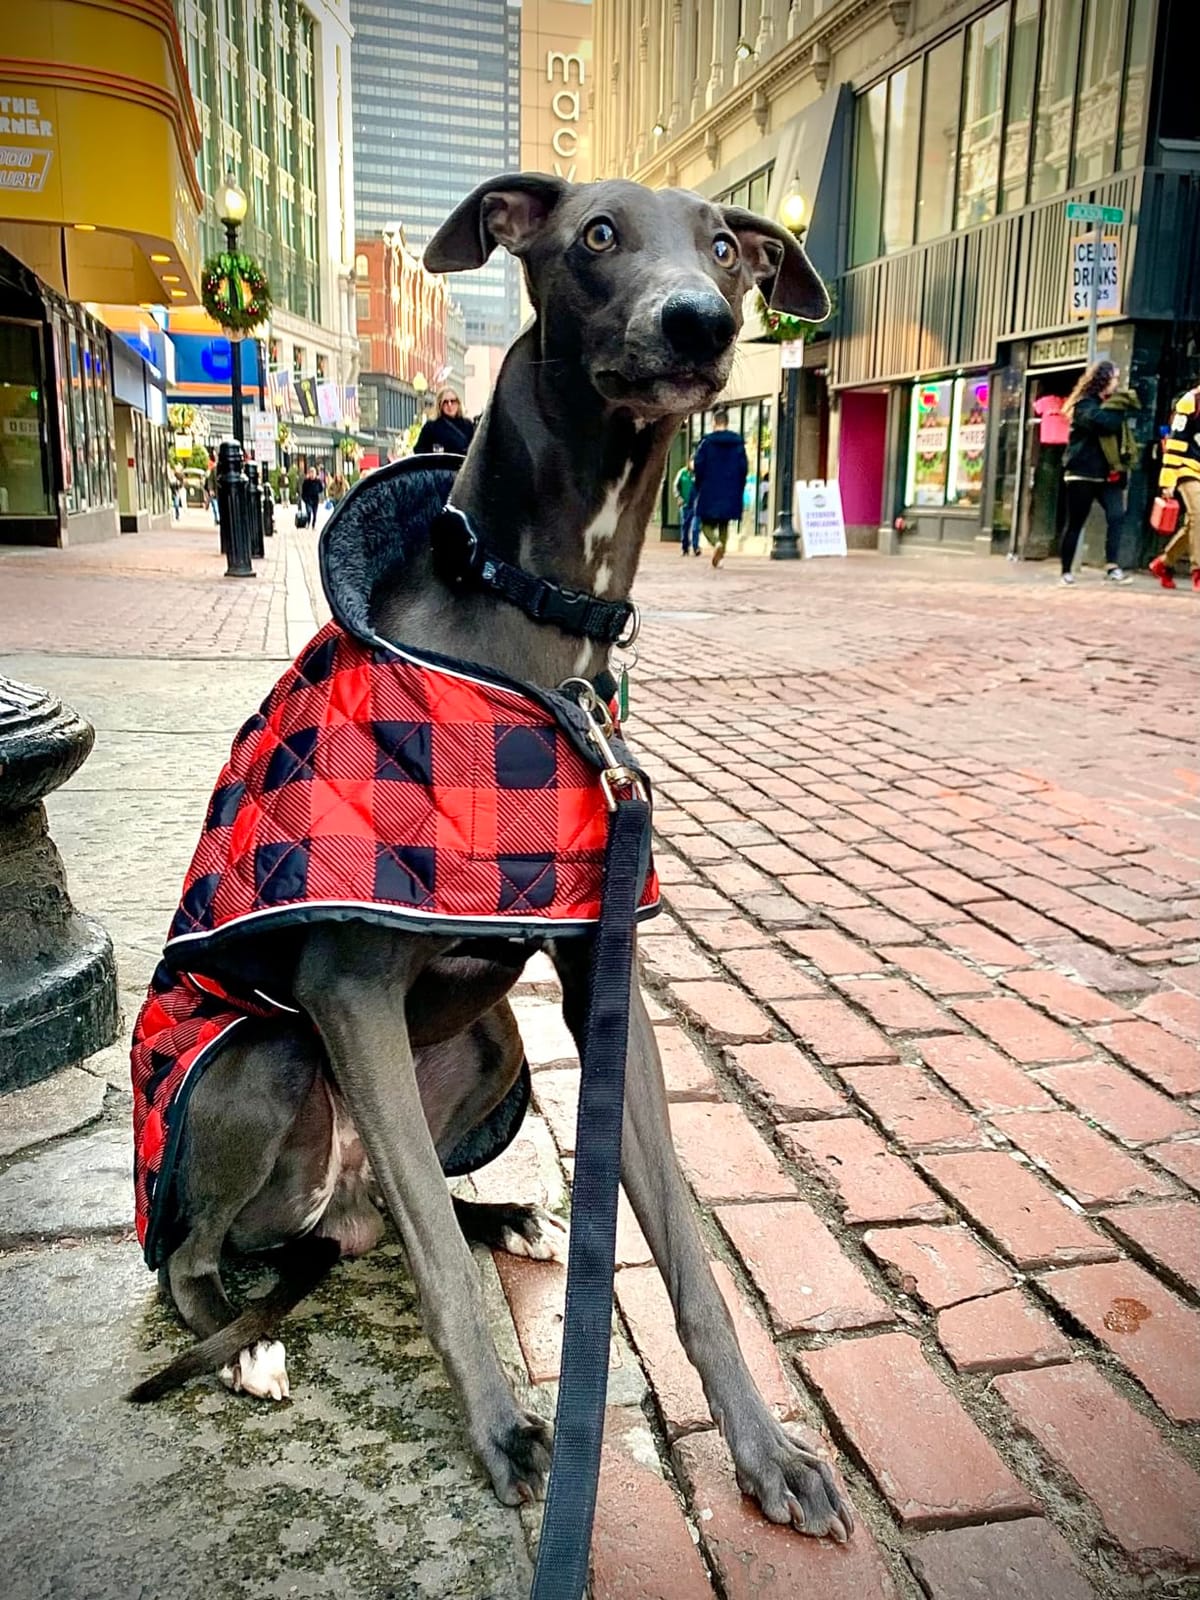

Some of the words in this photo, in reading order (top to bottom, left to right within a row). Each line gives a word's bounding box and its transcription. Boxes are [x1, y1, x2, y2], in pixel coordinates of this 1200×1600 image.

[0, 96, 40, 115] THE
[1074, 243, 1094, 261] ICE
[1033, 342, 1051, 362] THE
[1053, 338, 1089, 358] LOTTE
